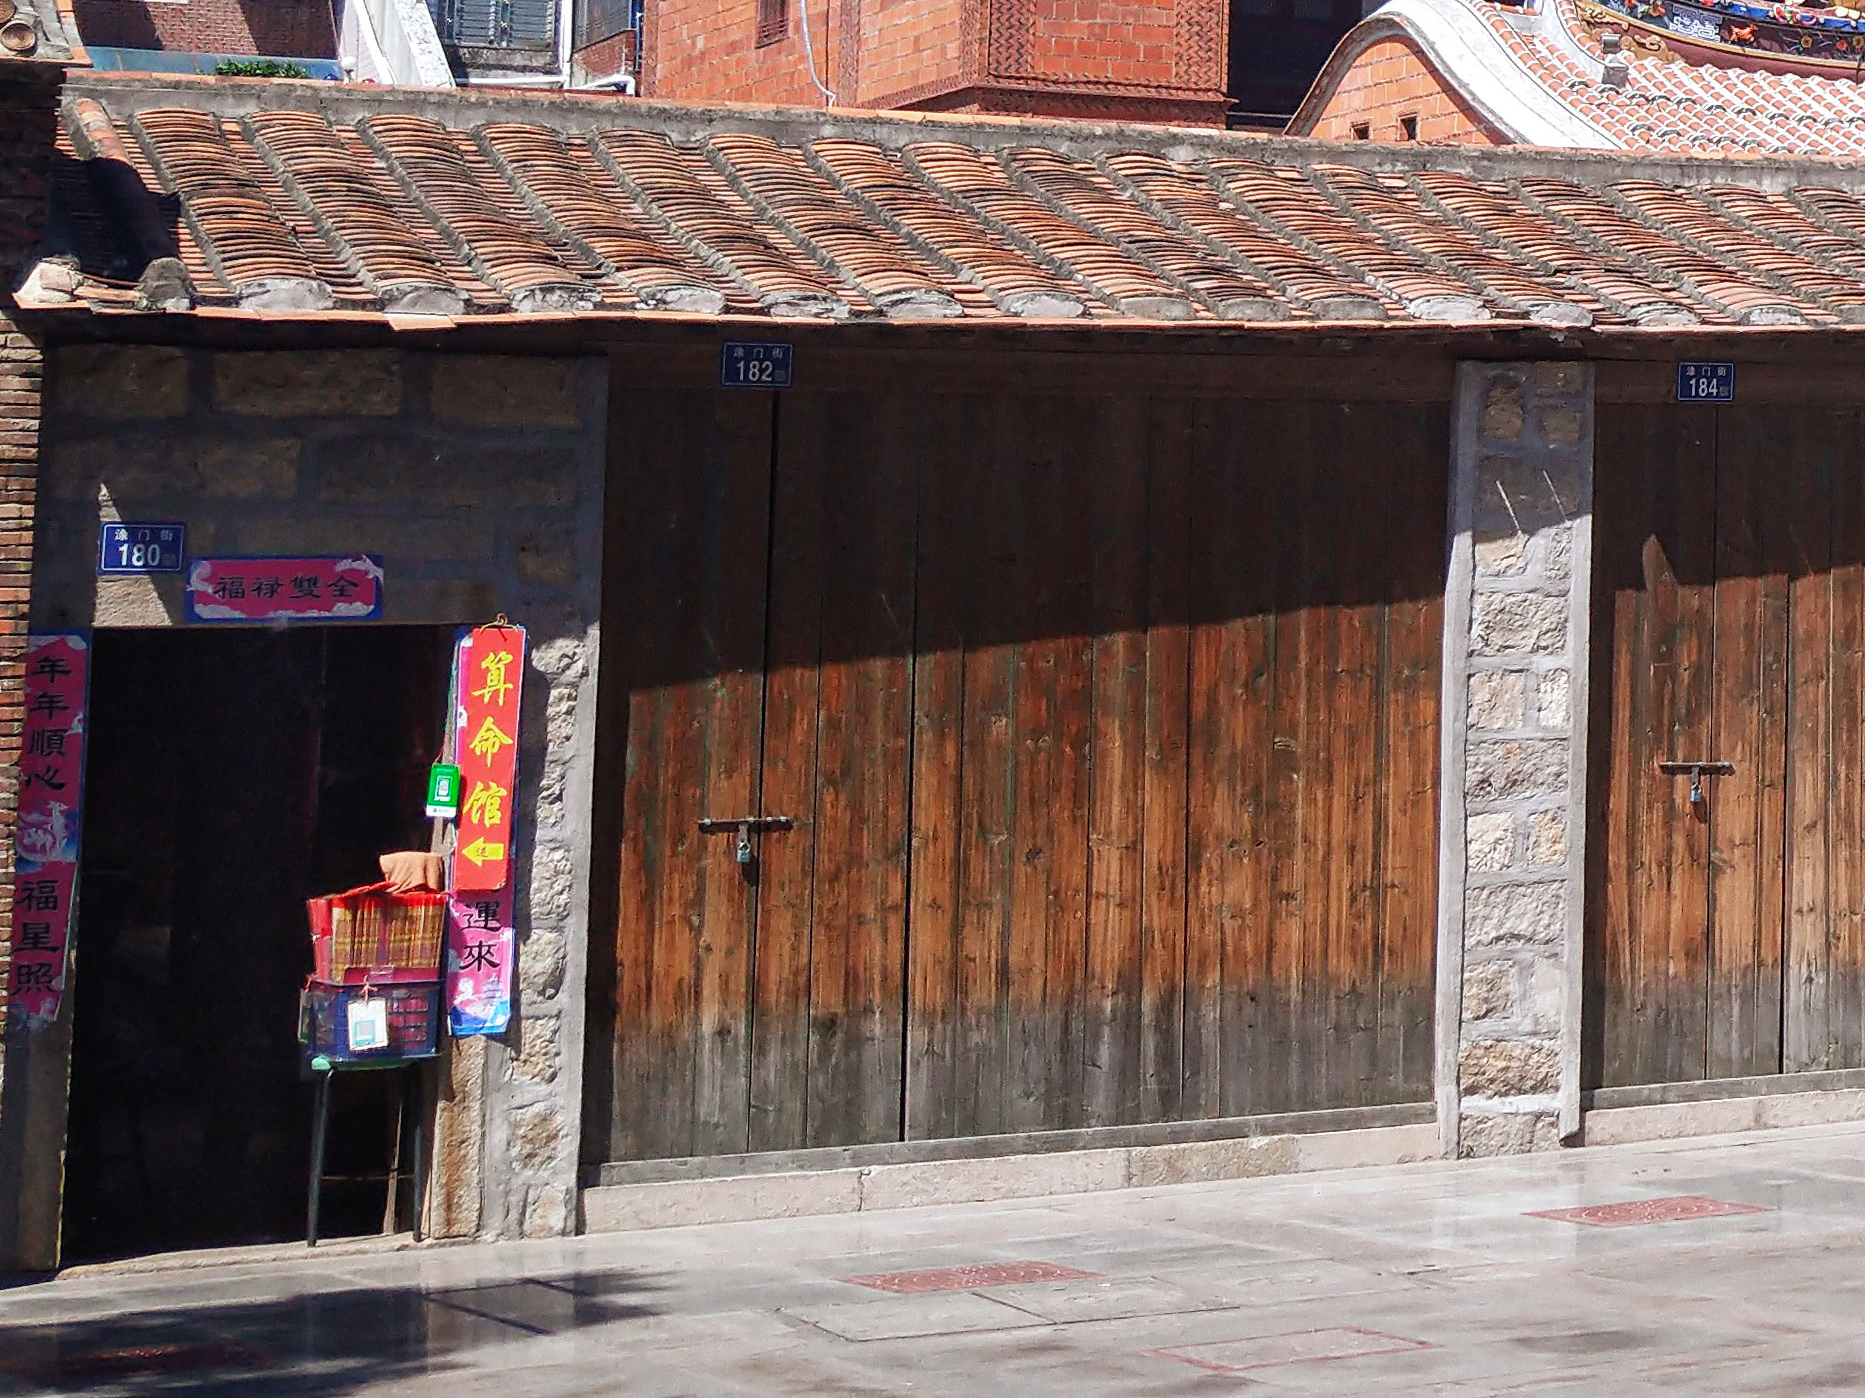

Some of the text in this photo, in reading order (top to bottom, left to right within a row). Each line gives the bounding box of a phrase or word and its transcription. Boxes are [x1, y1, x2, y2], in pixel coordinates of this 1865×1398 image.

[737, 361, 773, 381] 182
[1690, 378, 1718, 396] 184
[118, 543, 161, 566] 180
[462, 650, 513, 828] 算命馆
